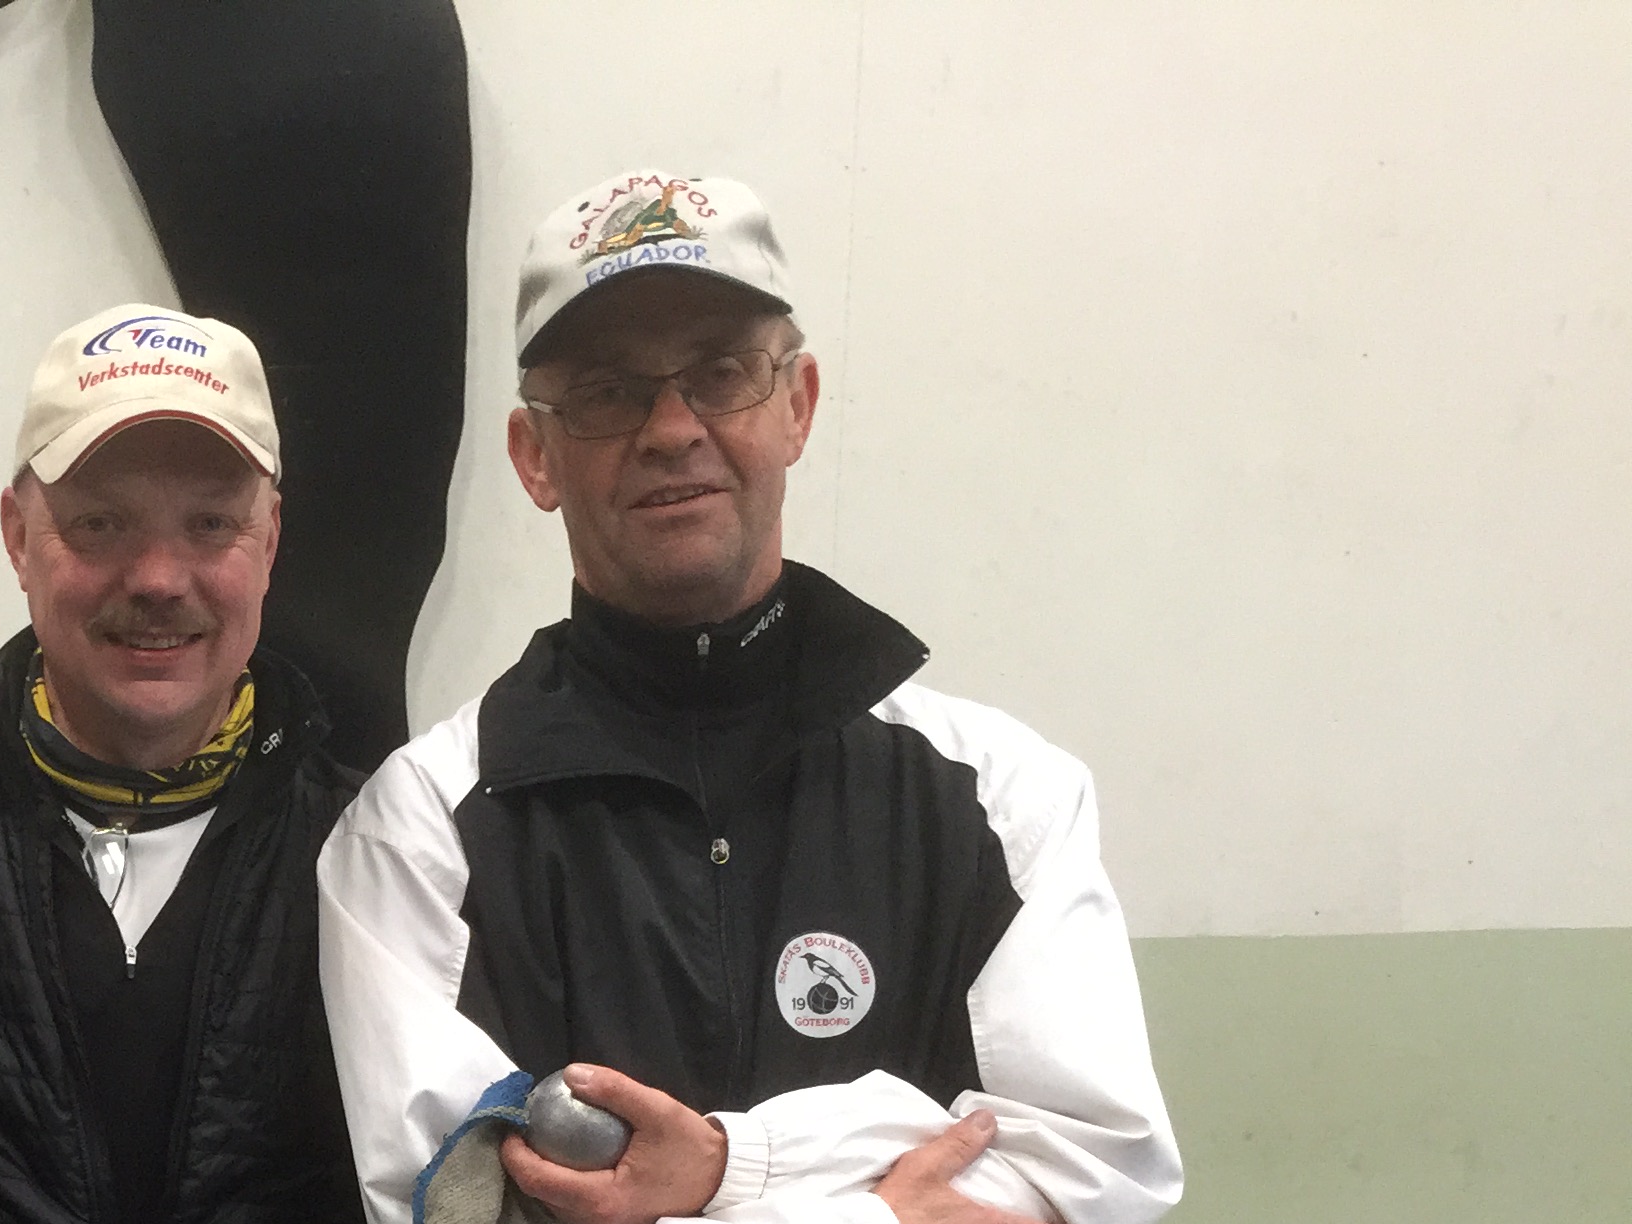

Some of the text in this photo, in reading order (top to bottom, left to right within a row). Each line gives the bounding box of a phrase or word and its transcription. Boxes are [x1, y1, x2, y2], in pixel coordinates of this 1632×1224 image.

[569, 175, 717, 249] GALAPAGOS
[127, 328, 208, 358] Team
[78, 357, 230, 395] Verkstadscenter
[791, 996, 854, 1011] 19 91
